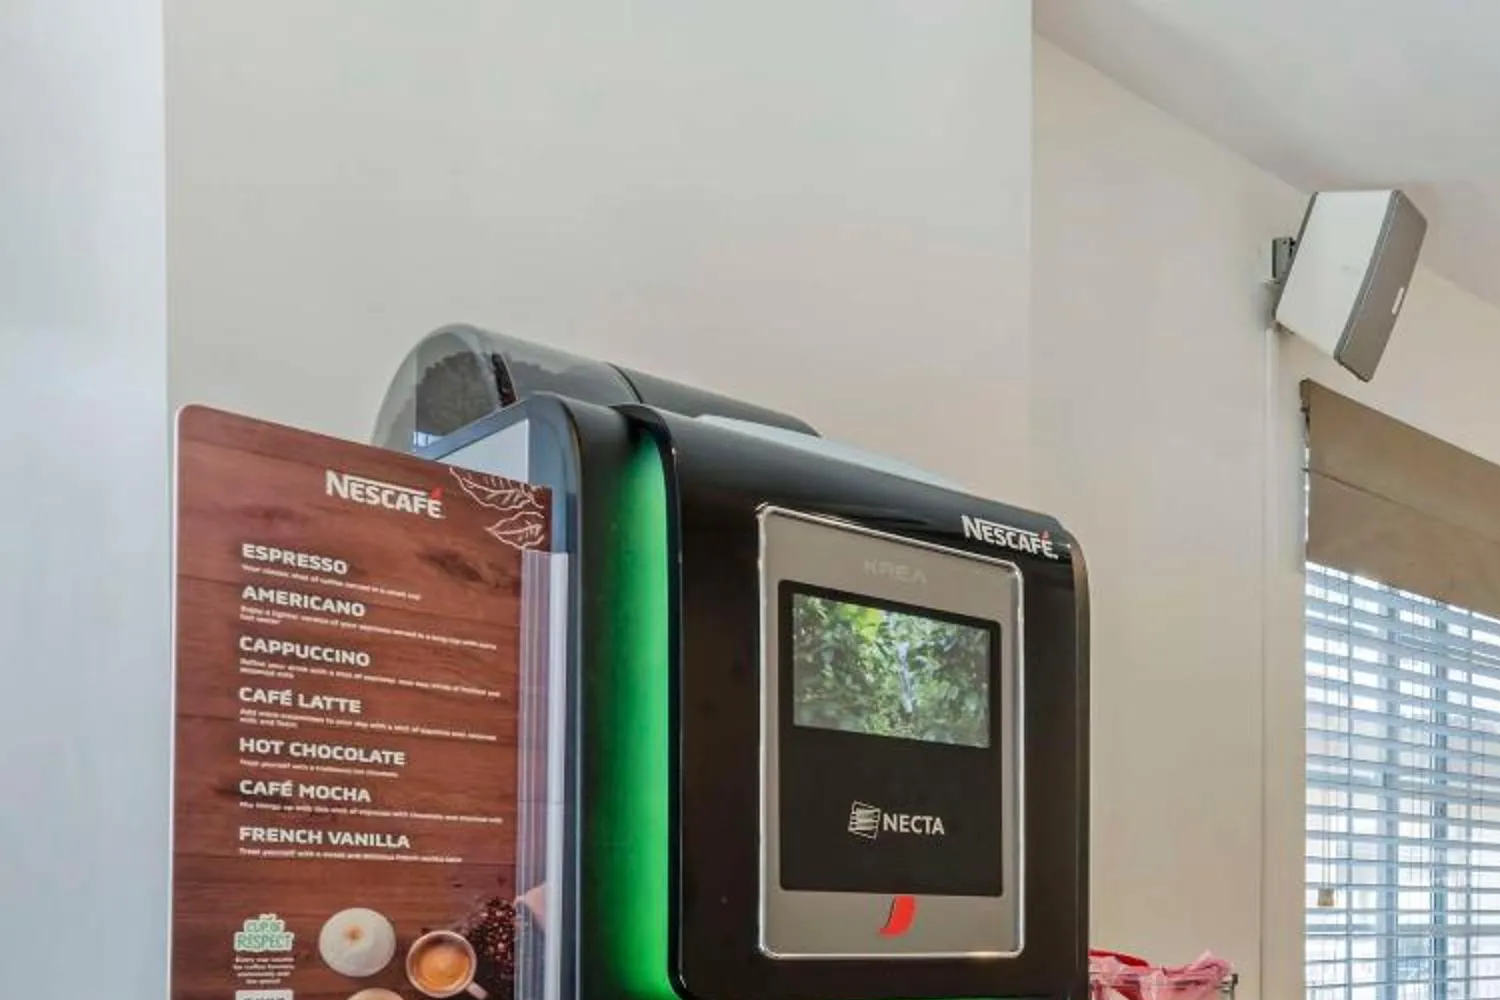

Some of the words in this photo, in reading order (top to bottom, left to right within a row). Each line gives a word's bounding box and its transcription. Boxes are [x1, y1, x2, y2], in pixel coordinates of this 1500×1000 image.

[324, 469, 446, 519] NESCAFÉ
[961, 514, 1059, 560] NESCAFÉ
[241, 543, 349, 575] ESPRESSO
[241, 584, 366, 617] AMERICANO
[239, 635, 371, 667] CAPPUCCINO
[239, 687, 293, 706] CAFÉ
[298, 693, 362, 714] LATTE
[239, 737, 284, 755] HOT
[289, 741, 406, 765] CHOCOLATE
[239, 778, 293, 797] CAFÉ
[299, 783, 372, 803] MOCHA
[239, 825, 323, 845] FRENCH
[327, 831, 411, 849] VANILLA
[882, 812, 945, 836] NECTA
